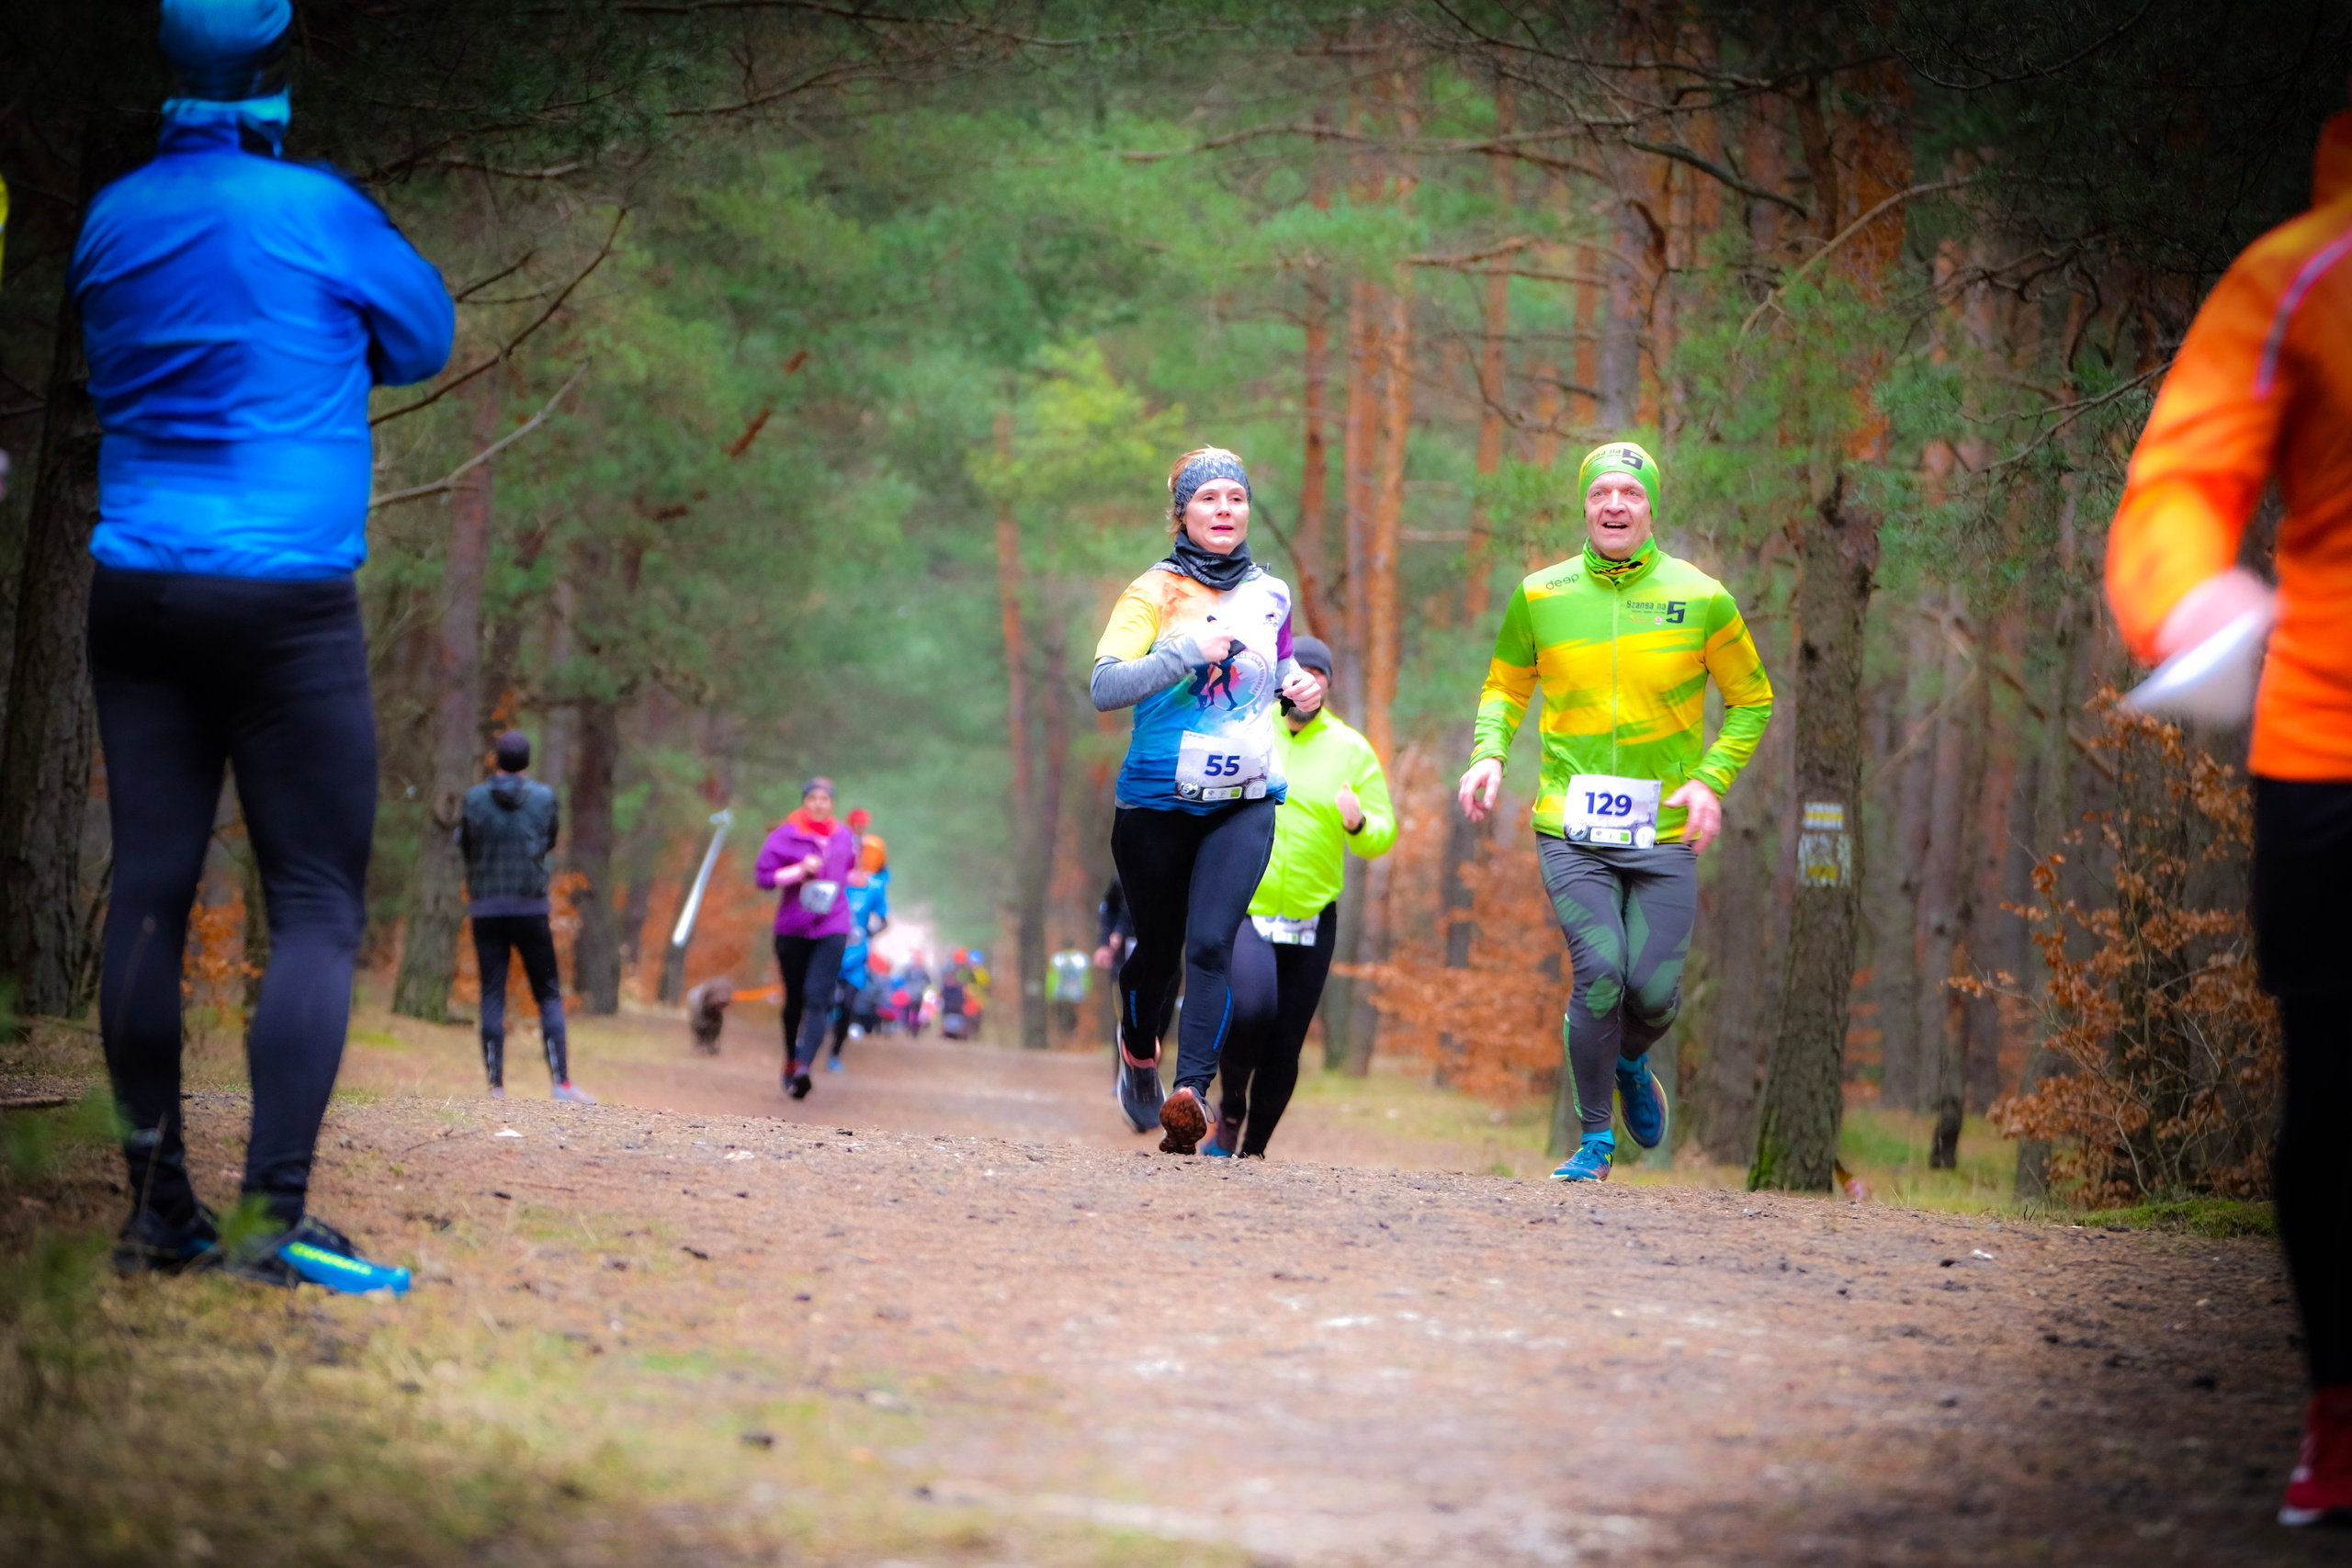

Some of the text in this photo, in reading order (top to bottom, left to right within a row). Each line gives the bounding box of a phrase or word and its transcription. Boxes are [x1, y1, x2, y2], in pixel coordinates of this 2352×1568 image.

[1621, 448, 1644, 470] 5
[1545, 573, 1579, 591] deep
[1626, 600, 1655, 610] Szansa
[1657, 603, 1667, 611] na
[1666, 600, 1687, 624] 5
[1204, 754, 1240, 777] 55
[1585, 792, 1632, 817] 129
